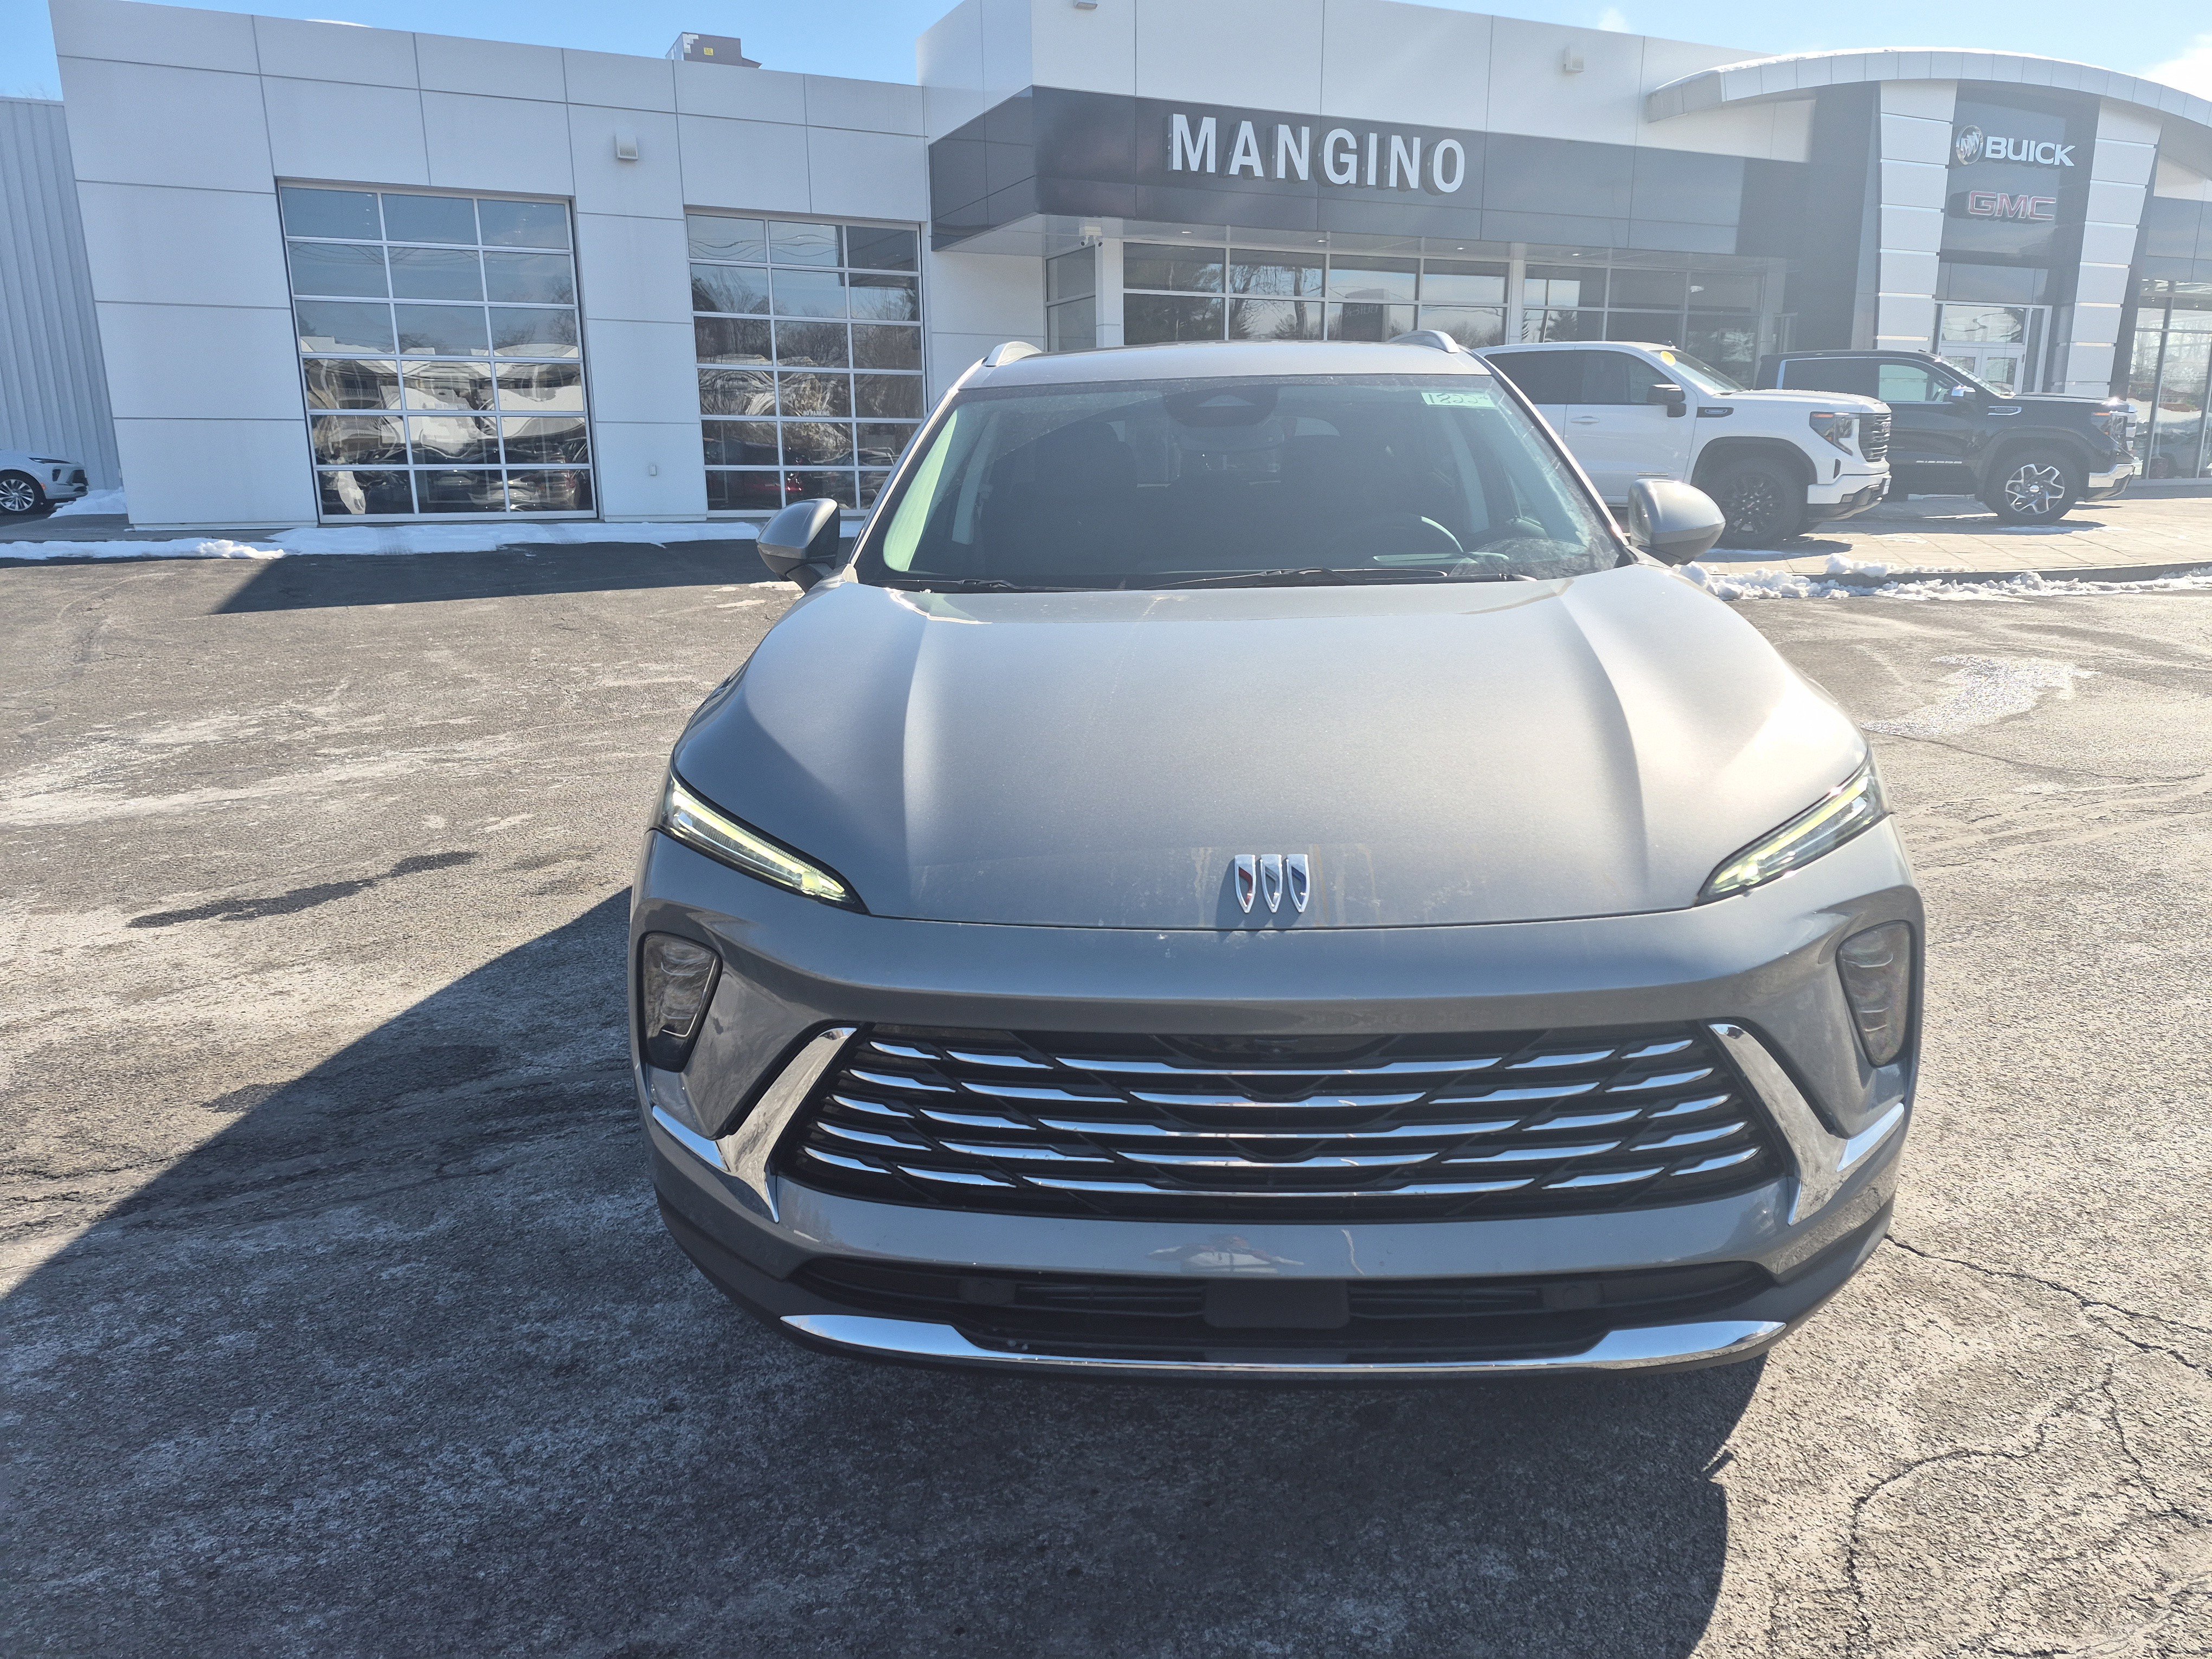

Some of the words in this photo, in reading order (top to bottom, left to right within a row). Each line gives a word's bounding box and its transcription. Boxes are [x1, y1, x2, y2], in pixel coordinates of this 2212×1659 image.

[1168, 113, 1465, 193] MANGINO
[1985, 136, 2075, 166] BUICK
[1969, 190, 2056, 221] GMC
